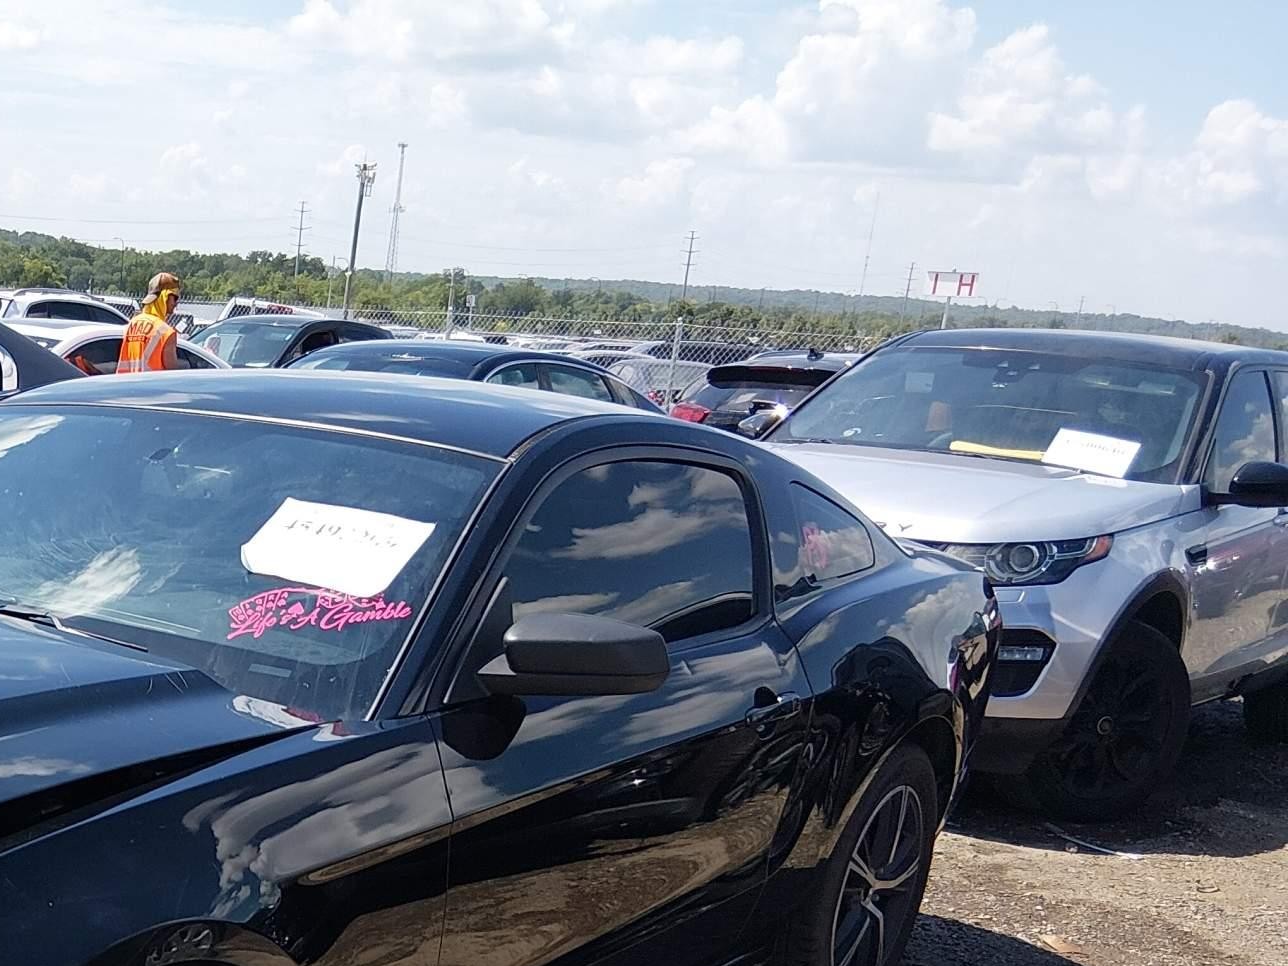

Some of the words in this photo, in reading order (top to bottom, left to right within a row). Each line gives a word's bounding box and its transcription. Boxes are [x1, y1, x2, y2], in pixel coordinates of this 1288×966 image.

[126, 320, 154, 335] MAD
[290, 607, 320, 629] A
[320, 600, 412, 631] Gamble
